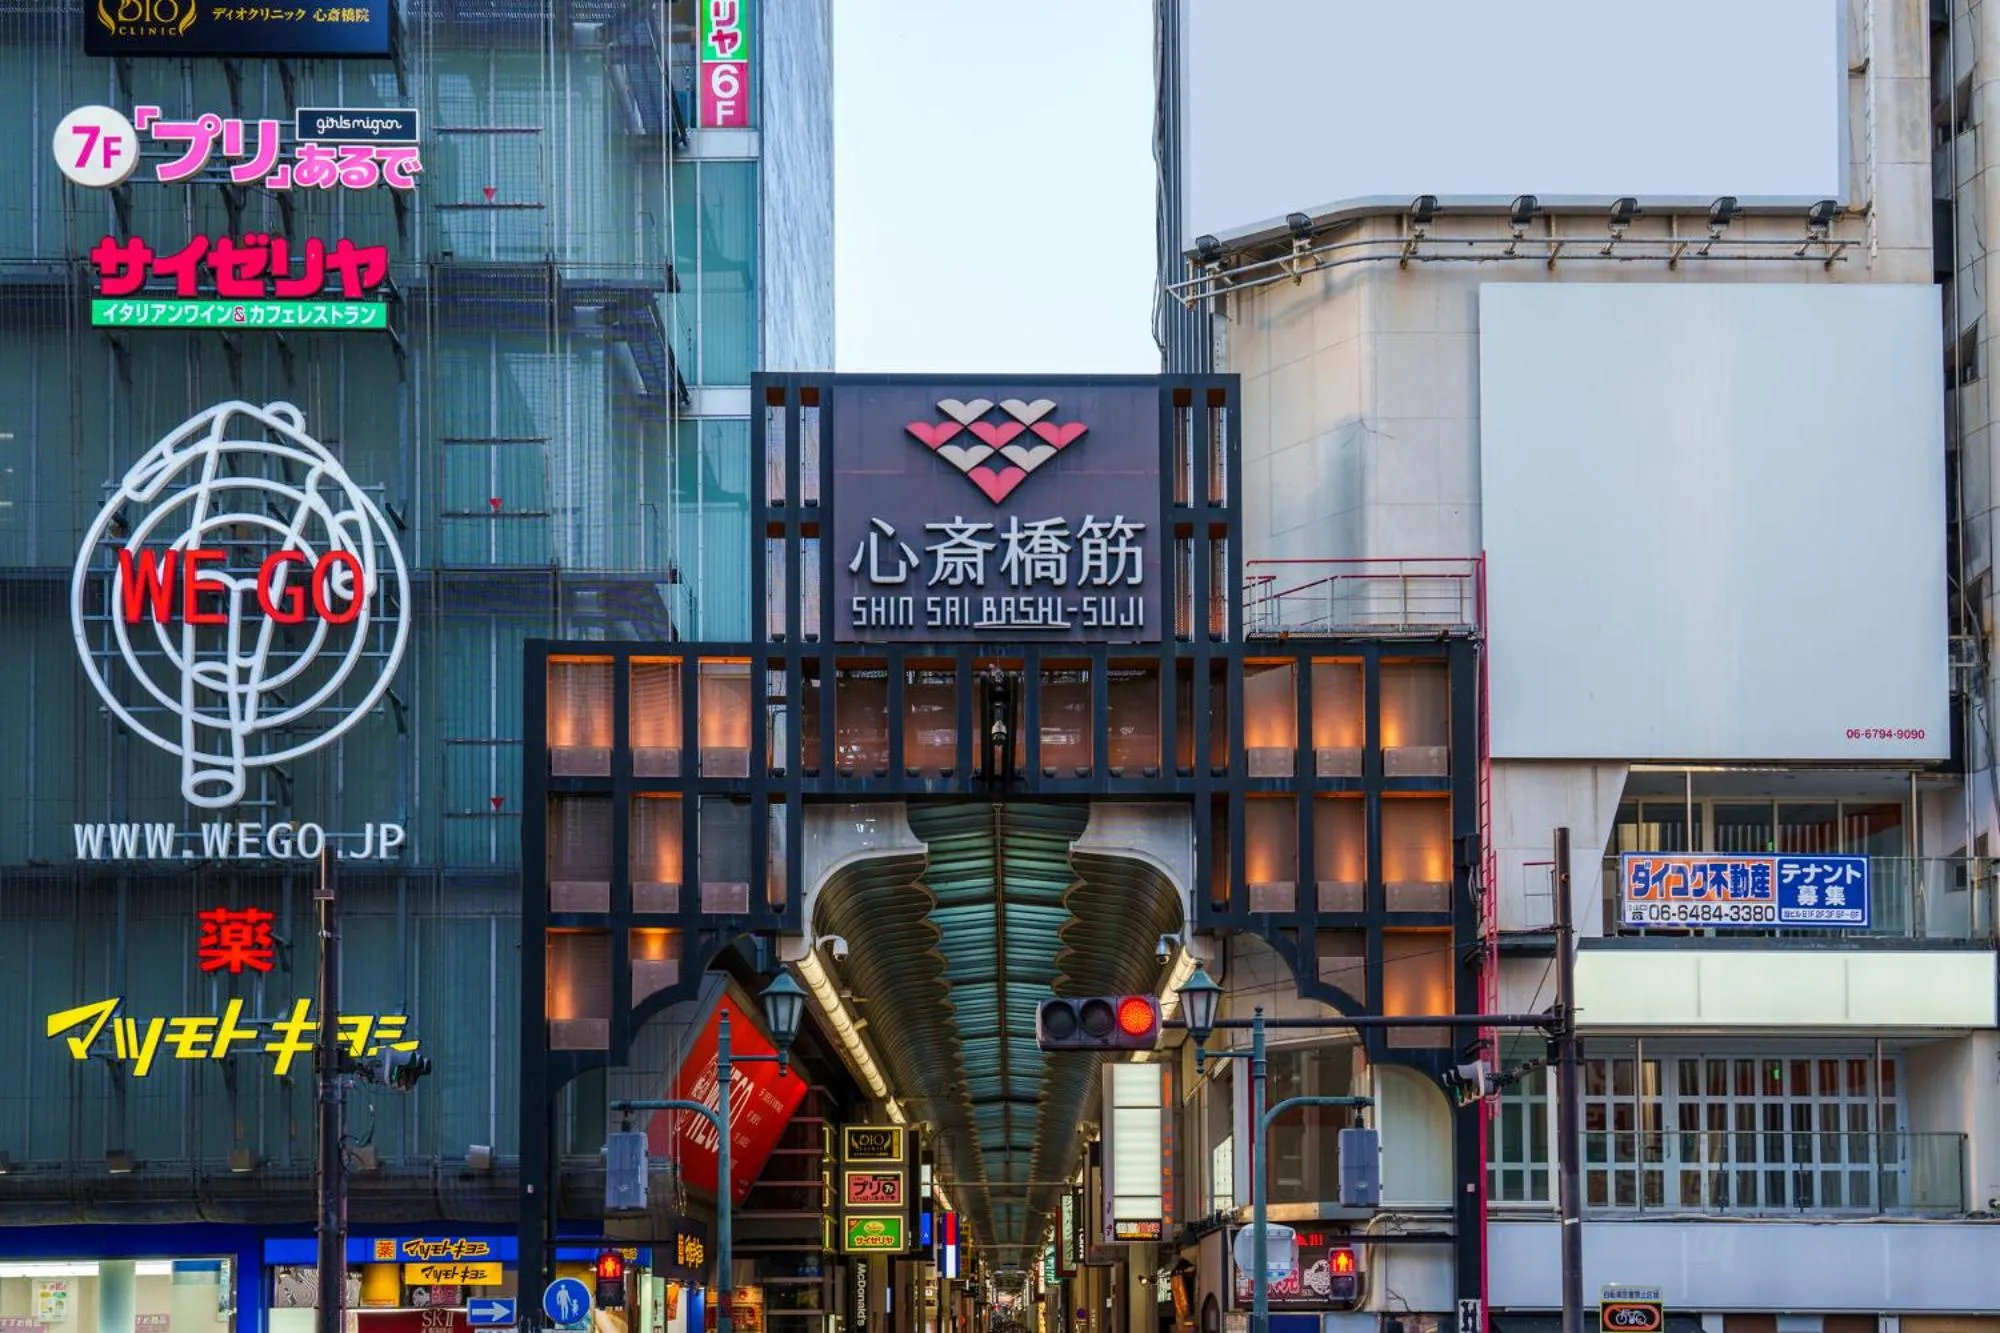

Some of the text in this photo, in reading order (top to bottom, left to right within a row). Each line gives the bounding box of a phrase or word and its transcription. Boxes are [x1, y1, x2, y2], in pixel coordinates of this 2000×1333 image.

[213, 8, 370, 22] ディオクリニック 心斎橋院
[119, 26, 178, 36] CLINIC
[71, 126, 122, 169] 7F
[294, 144, 420, 189] あるで
[92, 233, 388, 297] サイゼリヤ
[849, 516, 1147, 587] 心斎橋筋
[853, 597, 913, 626] SHIN
[927, 597, 969, 626] SAI
[1847, 729, 1924, 739] 06-6794-9090
[74, 823, 405, 859] WWW.WEGO.JP
[1631, 861, 1771, 898] ダイコク不動産
[1781, 864, 1862, 884] テナント
[1797, 886, 1846, 906] 募集
[1648, 903, 1775, 922] 06-6484-3380
[198, 907, 275, 974] 薬
[402, 1239, 490, 1260] マツモトキヨシ
[421, 1265, 488, 1282] マツモトキヨシ
[857, 1263, 867, 1327] McDonald's
